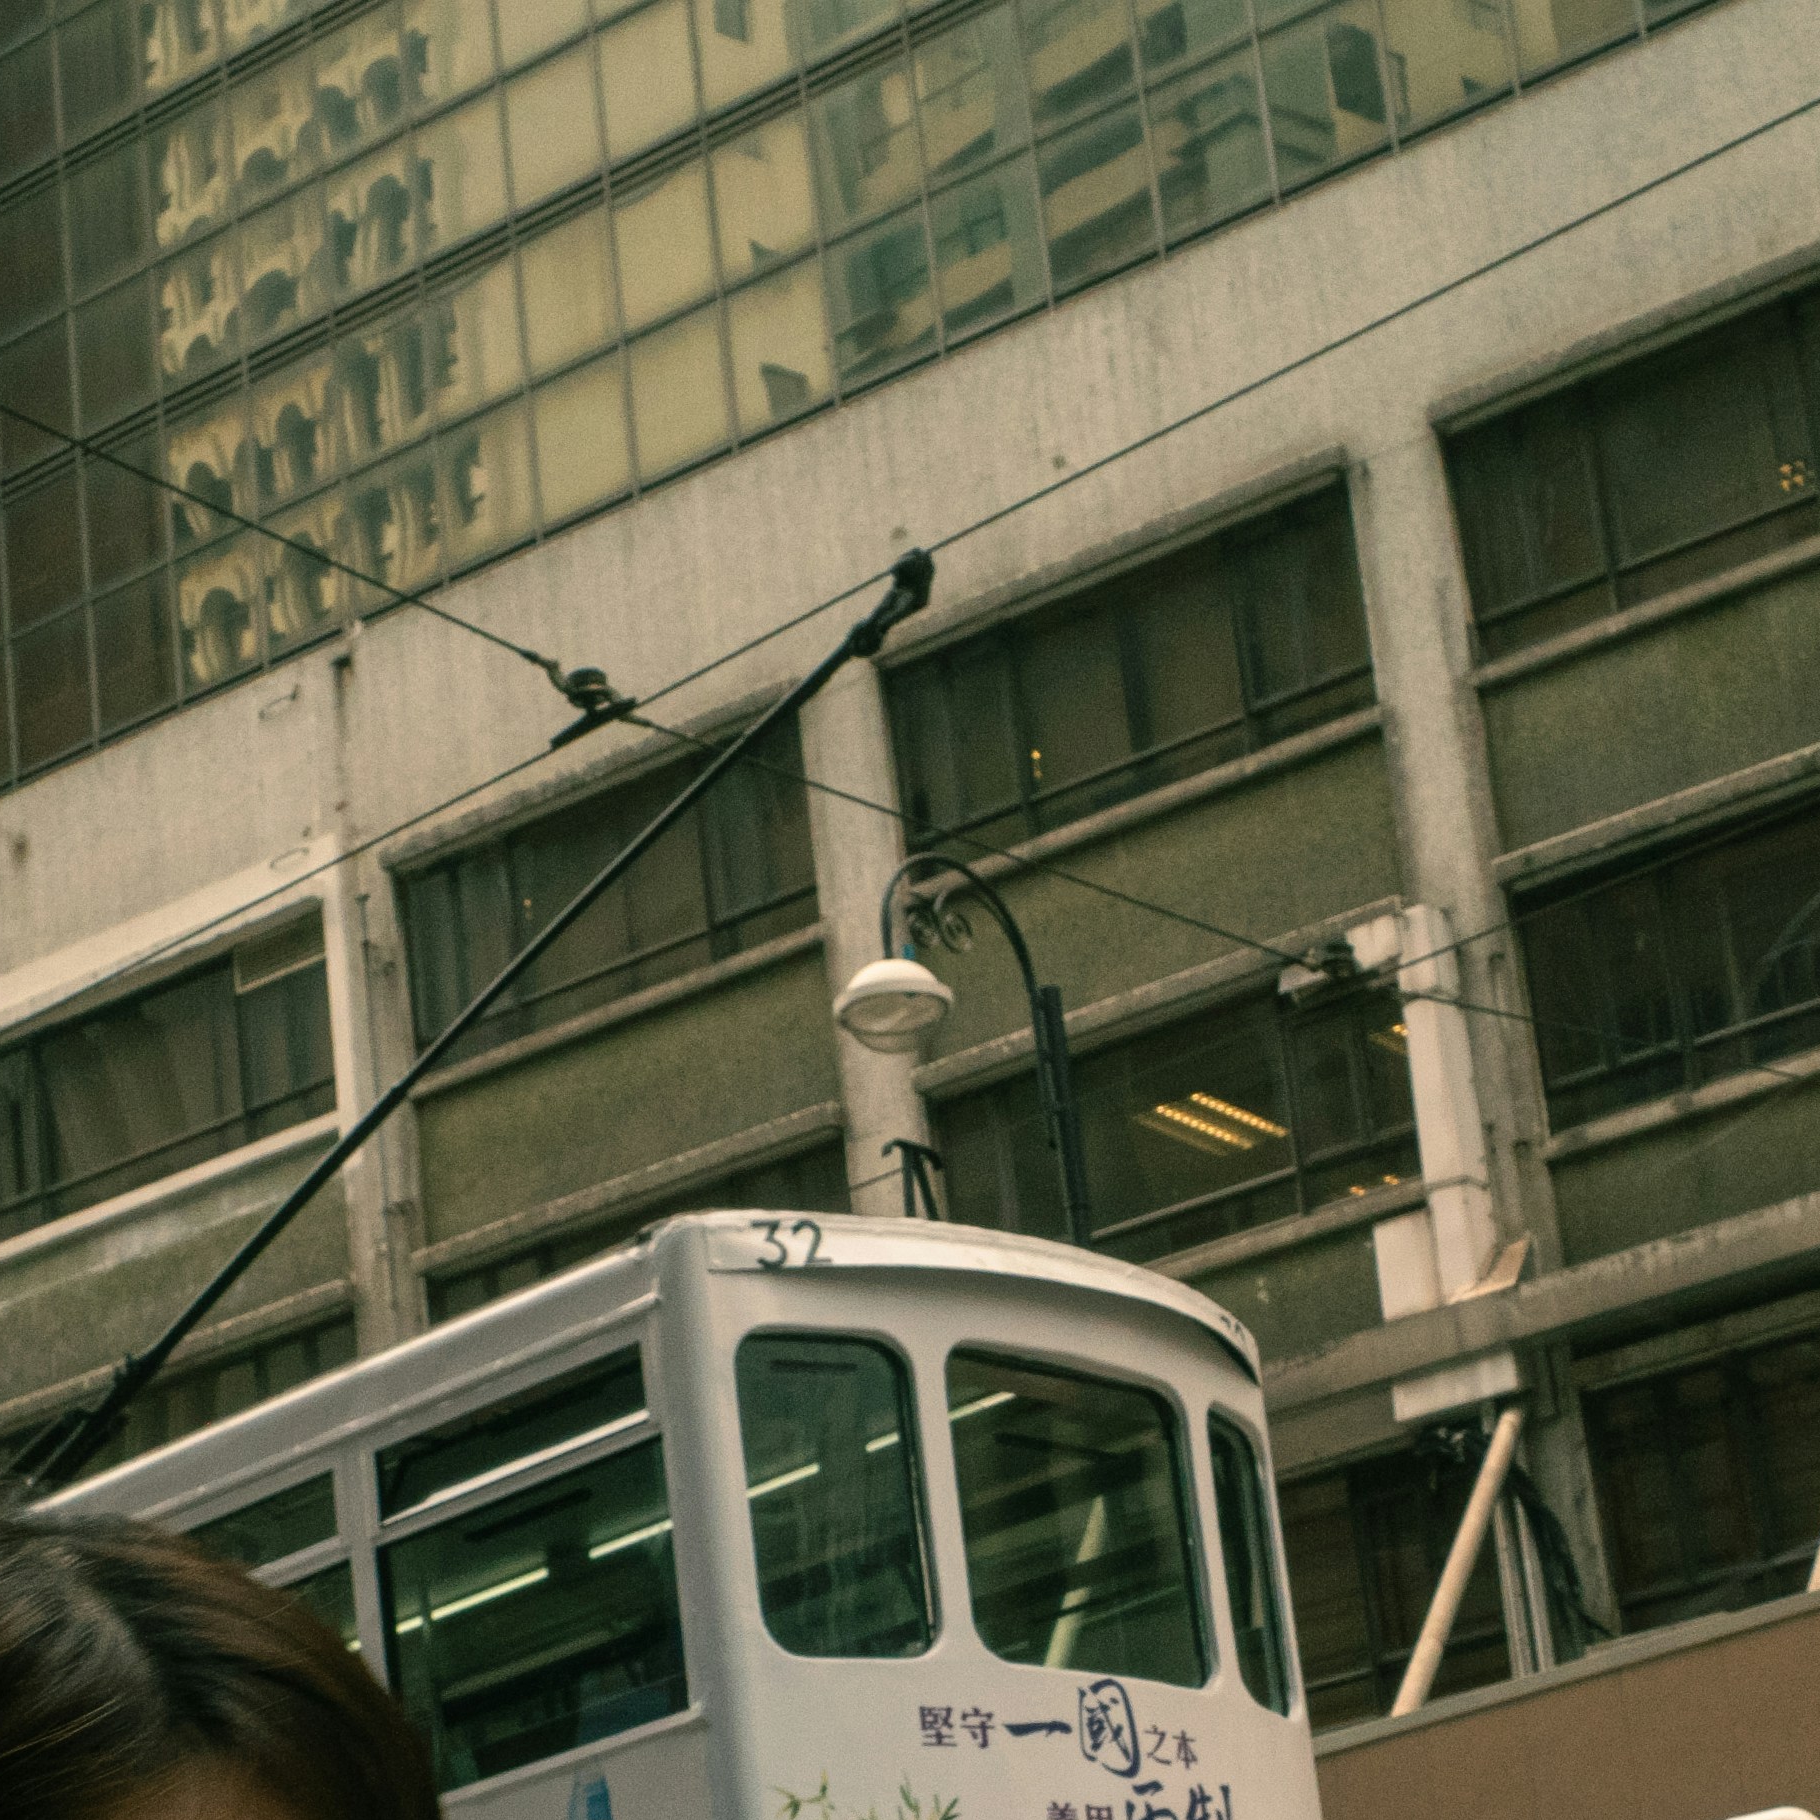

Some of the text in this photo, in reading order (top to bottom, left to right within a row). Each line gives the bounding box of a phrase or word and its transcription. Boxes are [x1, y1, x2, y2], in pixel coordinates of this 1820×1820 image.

[750, 1219, 832, 1268] 32
[919, 1679, 1198, 1779] 堅守一國之本
